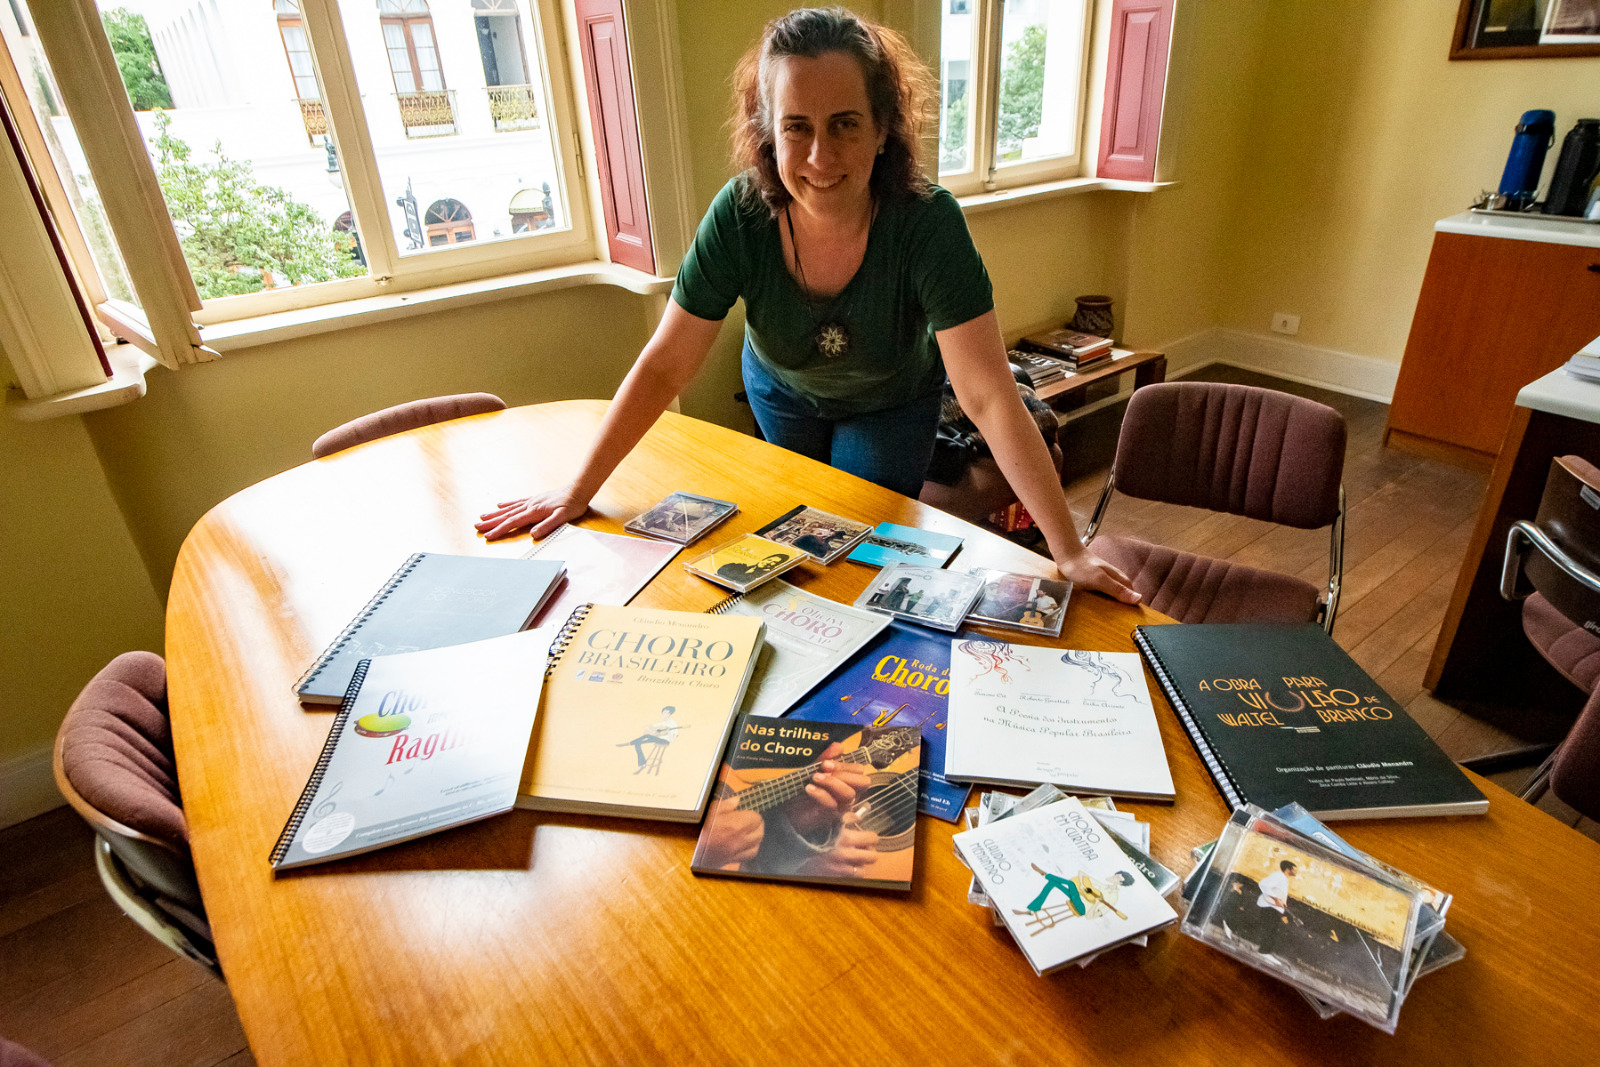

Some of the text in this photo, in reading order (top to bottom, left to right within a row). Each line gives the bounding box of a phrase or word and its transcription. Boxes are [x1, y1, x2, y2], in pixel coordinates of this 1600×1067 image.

[762, 603, 843, 638] CHORO
[587, 629, 734, 662] CHORO
[577, 651, 726, 679] BRASILEIRO
[874, 655, 950, 695] Choro
[911, 659, 938, 673] Roda
[637, 675, 720, 689] Brazilian Choro
[1199, 676, 1328, 691] A OBRA PARA
[1363, 696, 1381, 704] DE
[996, 705, 1006, 714] A
[1057, 716, 1118, 725] Instrumentos
[1217, 706, 1393, 727] WALTEL BRANCO
[745, 723, 830, 741] Nas trilhas
[983, 716, 996, 724] na
[1039, 727, 1079, 738] Popular
[1083, 728, 1132, 738] Brasileira
[740, 739, 813, 756] do Choro
[1053, 814, 1099, 861] EM CURITIBA
[1068, 811, 1101, 844] CHORO
